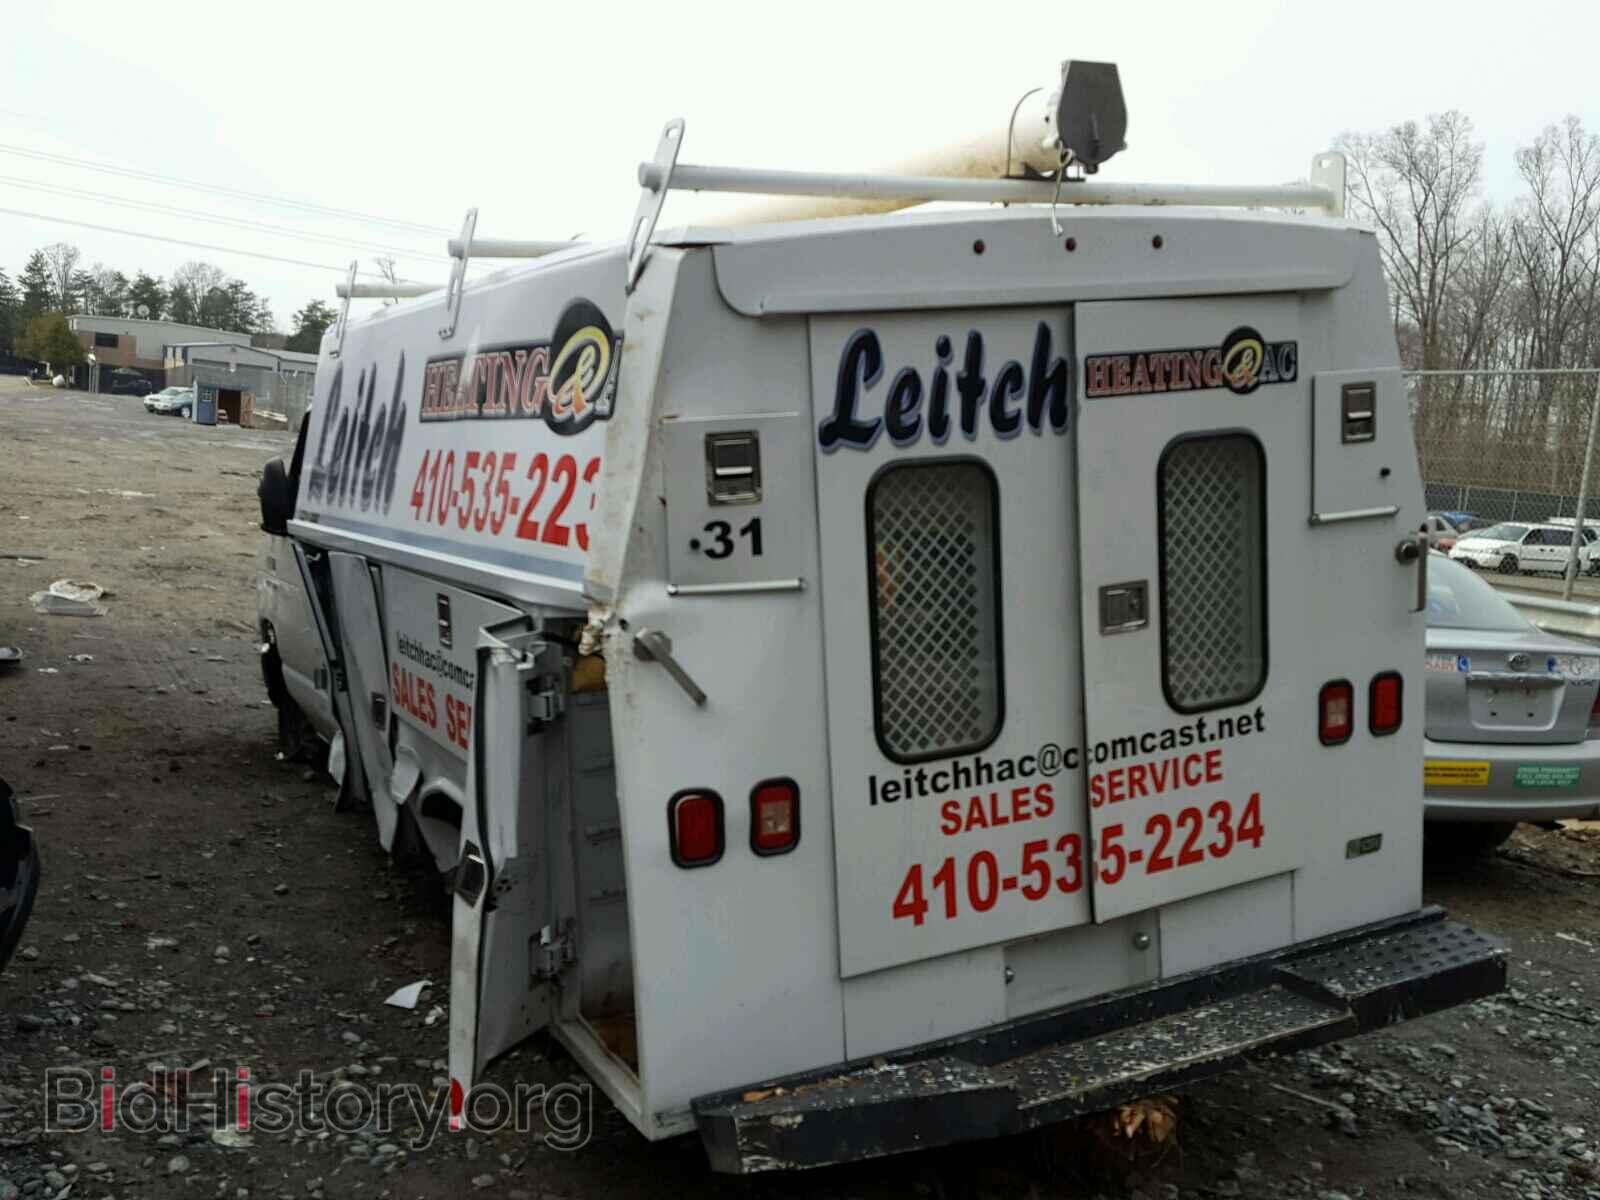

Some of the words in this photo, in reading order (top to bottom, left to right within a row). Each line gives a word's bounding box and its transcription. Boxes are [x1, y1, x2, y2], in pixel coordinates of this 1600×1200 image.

[421, 346, 553, 418] HEATING
[819, 320, 1070, 454] Leitch
[1087, 350, 1223, 395] HEATING
[1259, 343, 1297, 381] AC
[307, 350, 407, 517] Leitch
[392, 661, 438, 730] SALES
[940, 783, 1056, 836] SALES
[1089, 748, 1223, 809] SERVICE
[892, 792, 1265, 927] 410-535-2234
